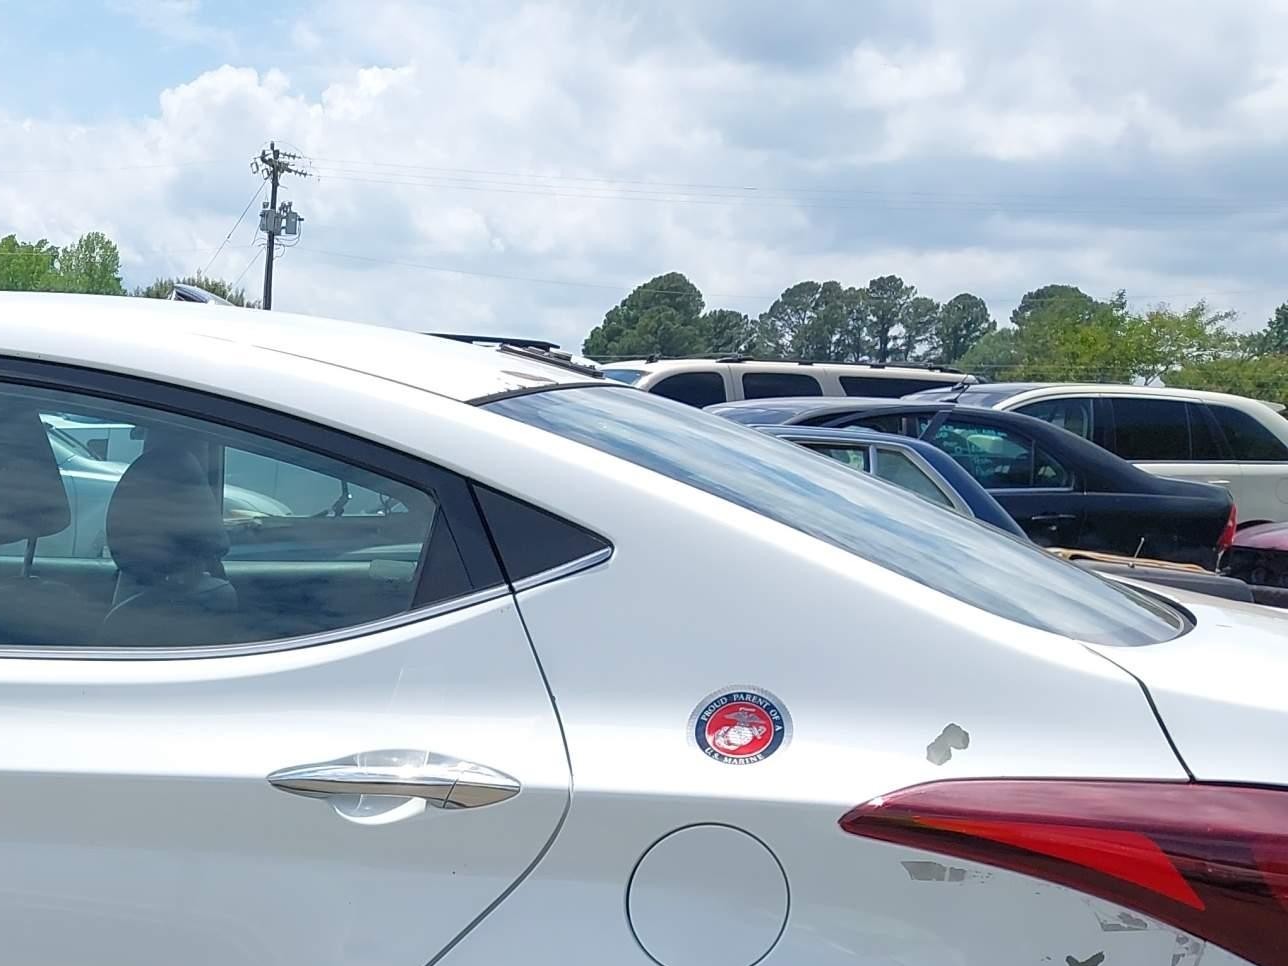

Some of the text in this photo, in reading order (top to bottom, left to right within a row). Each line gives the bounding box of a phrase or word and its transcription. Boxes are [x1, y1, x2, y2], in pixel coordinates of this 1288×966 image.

[700, 694, 784, 732] PROUD PARENT OF A
[723, 754, 765, 765] MARINE
